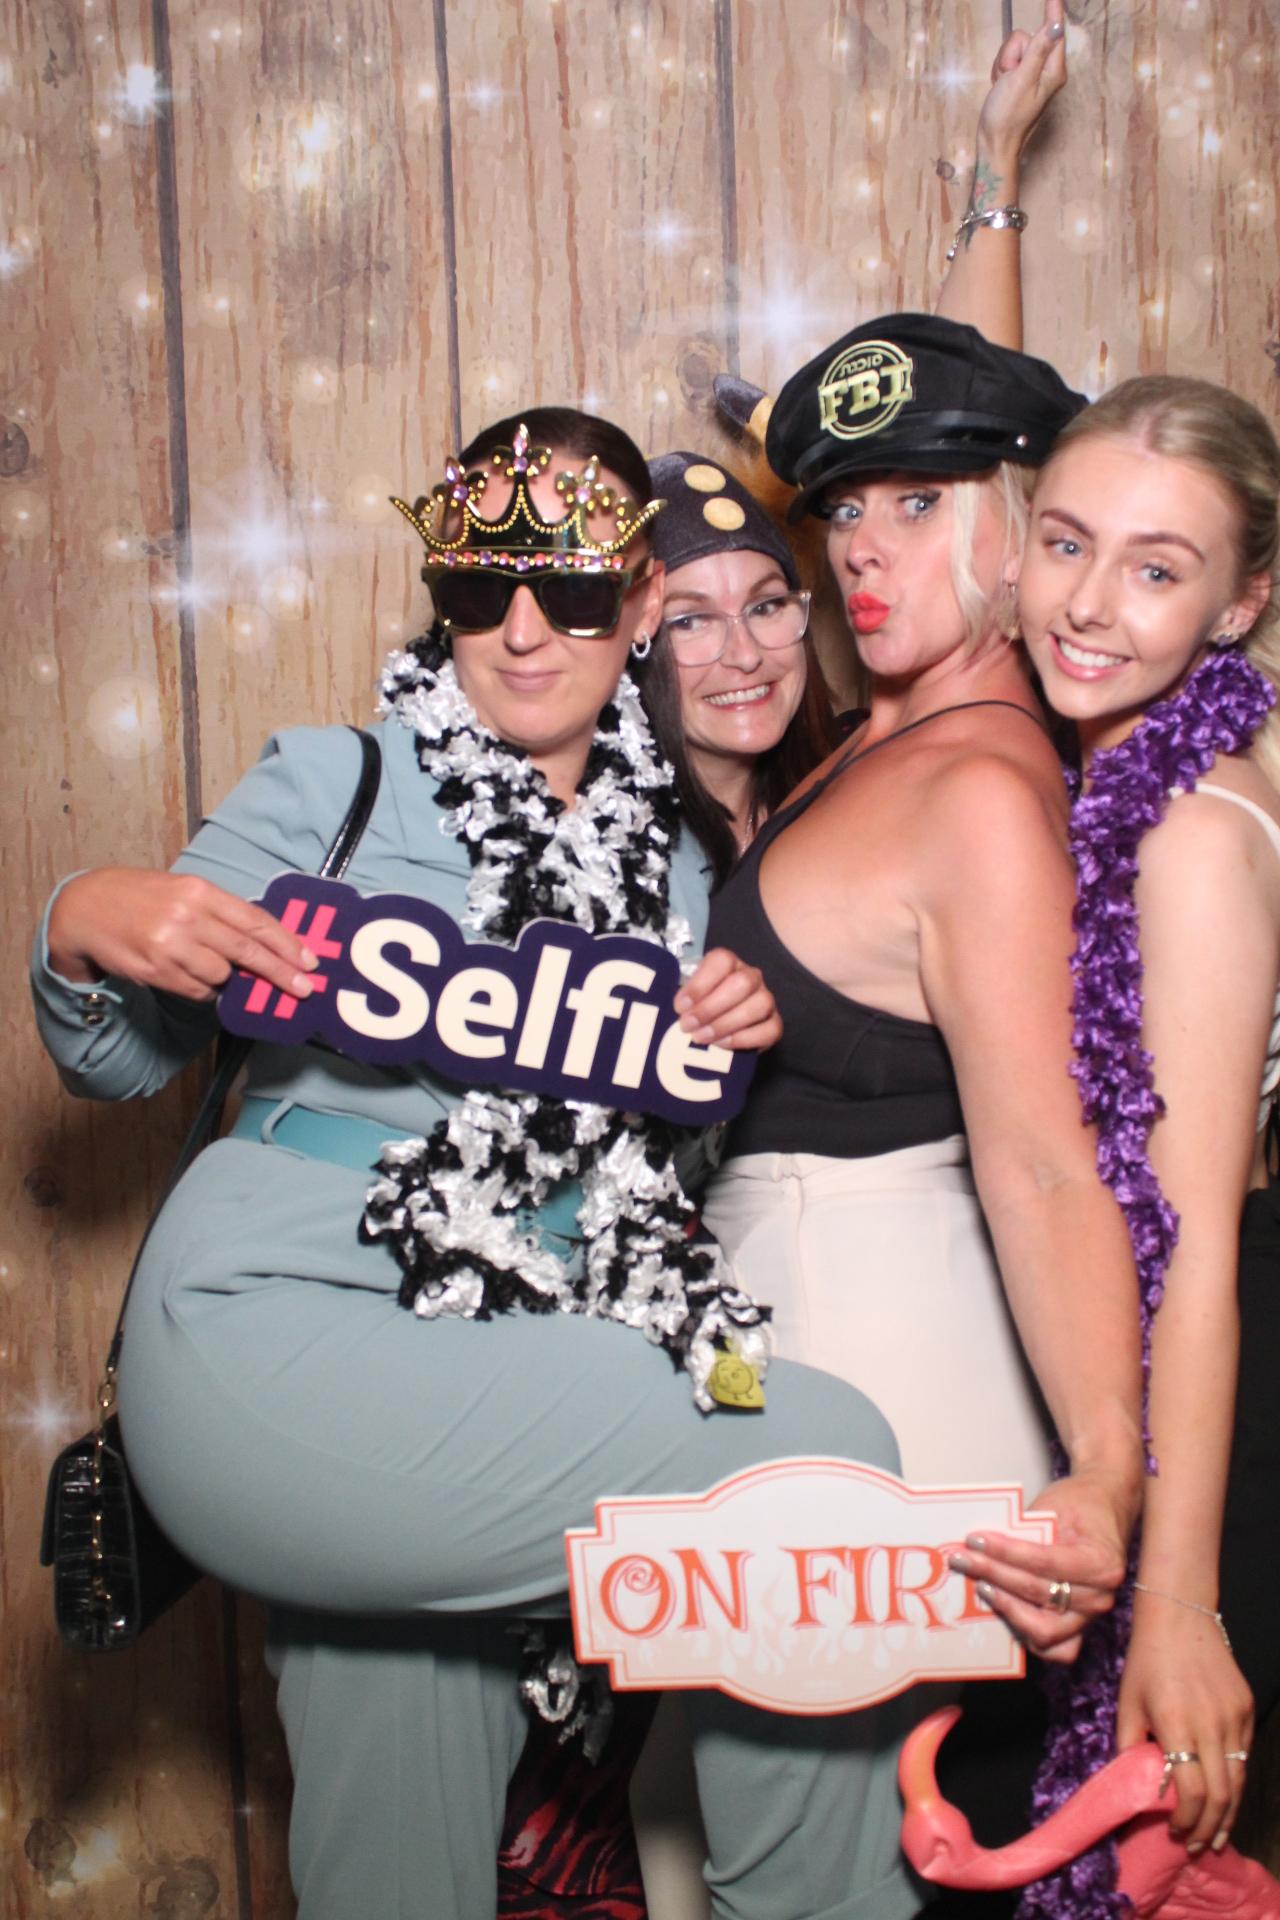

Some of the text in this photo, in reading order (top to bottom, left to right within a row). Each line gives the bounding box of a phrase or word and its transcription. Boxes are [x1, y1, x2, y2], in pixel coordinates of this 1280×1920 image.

[818, 358, 913, 430] FBI
[239, 898, 734, 1102] #Selfie
[600, 1547, 755, 1637] ON
